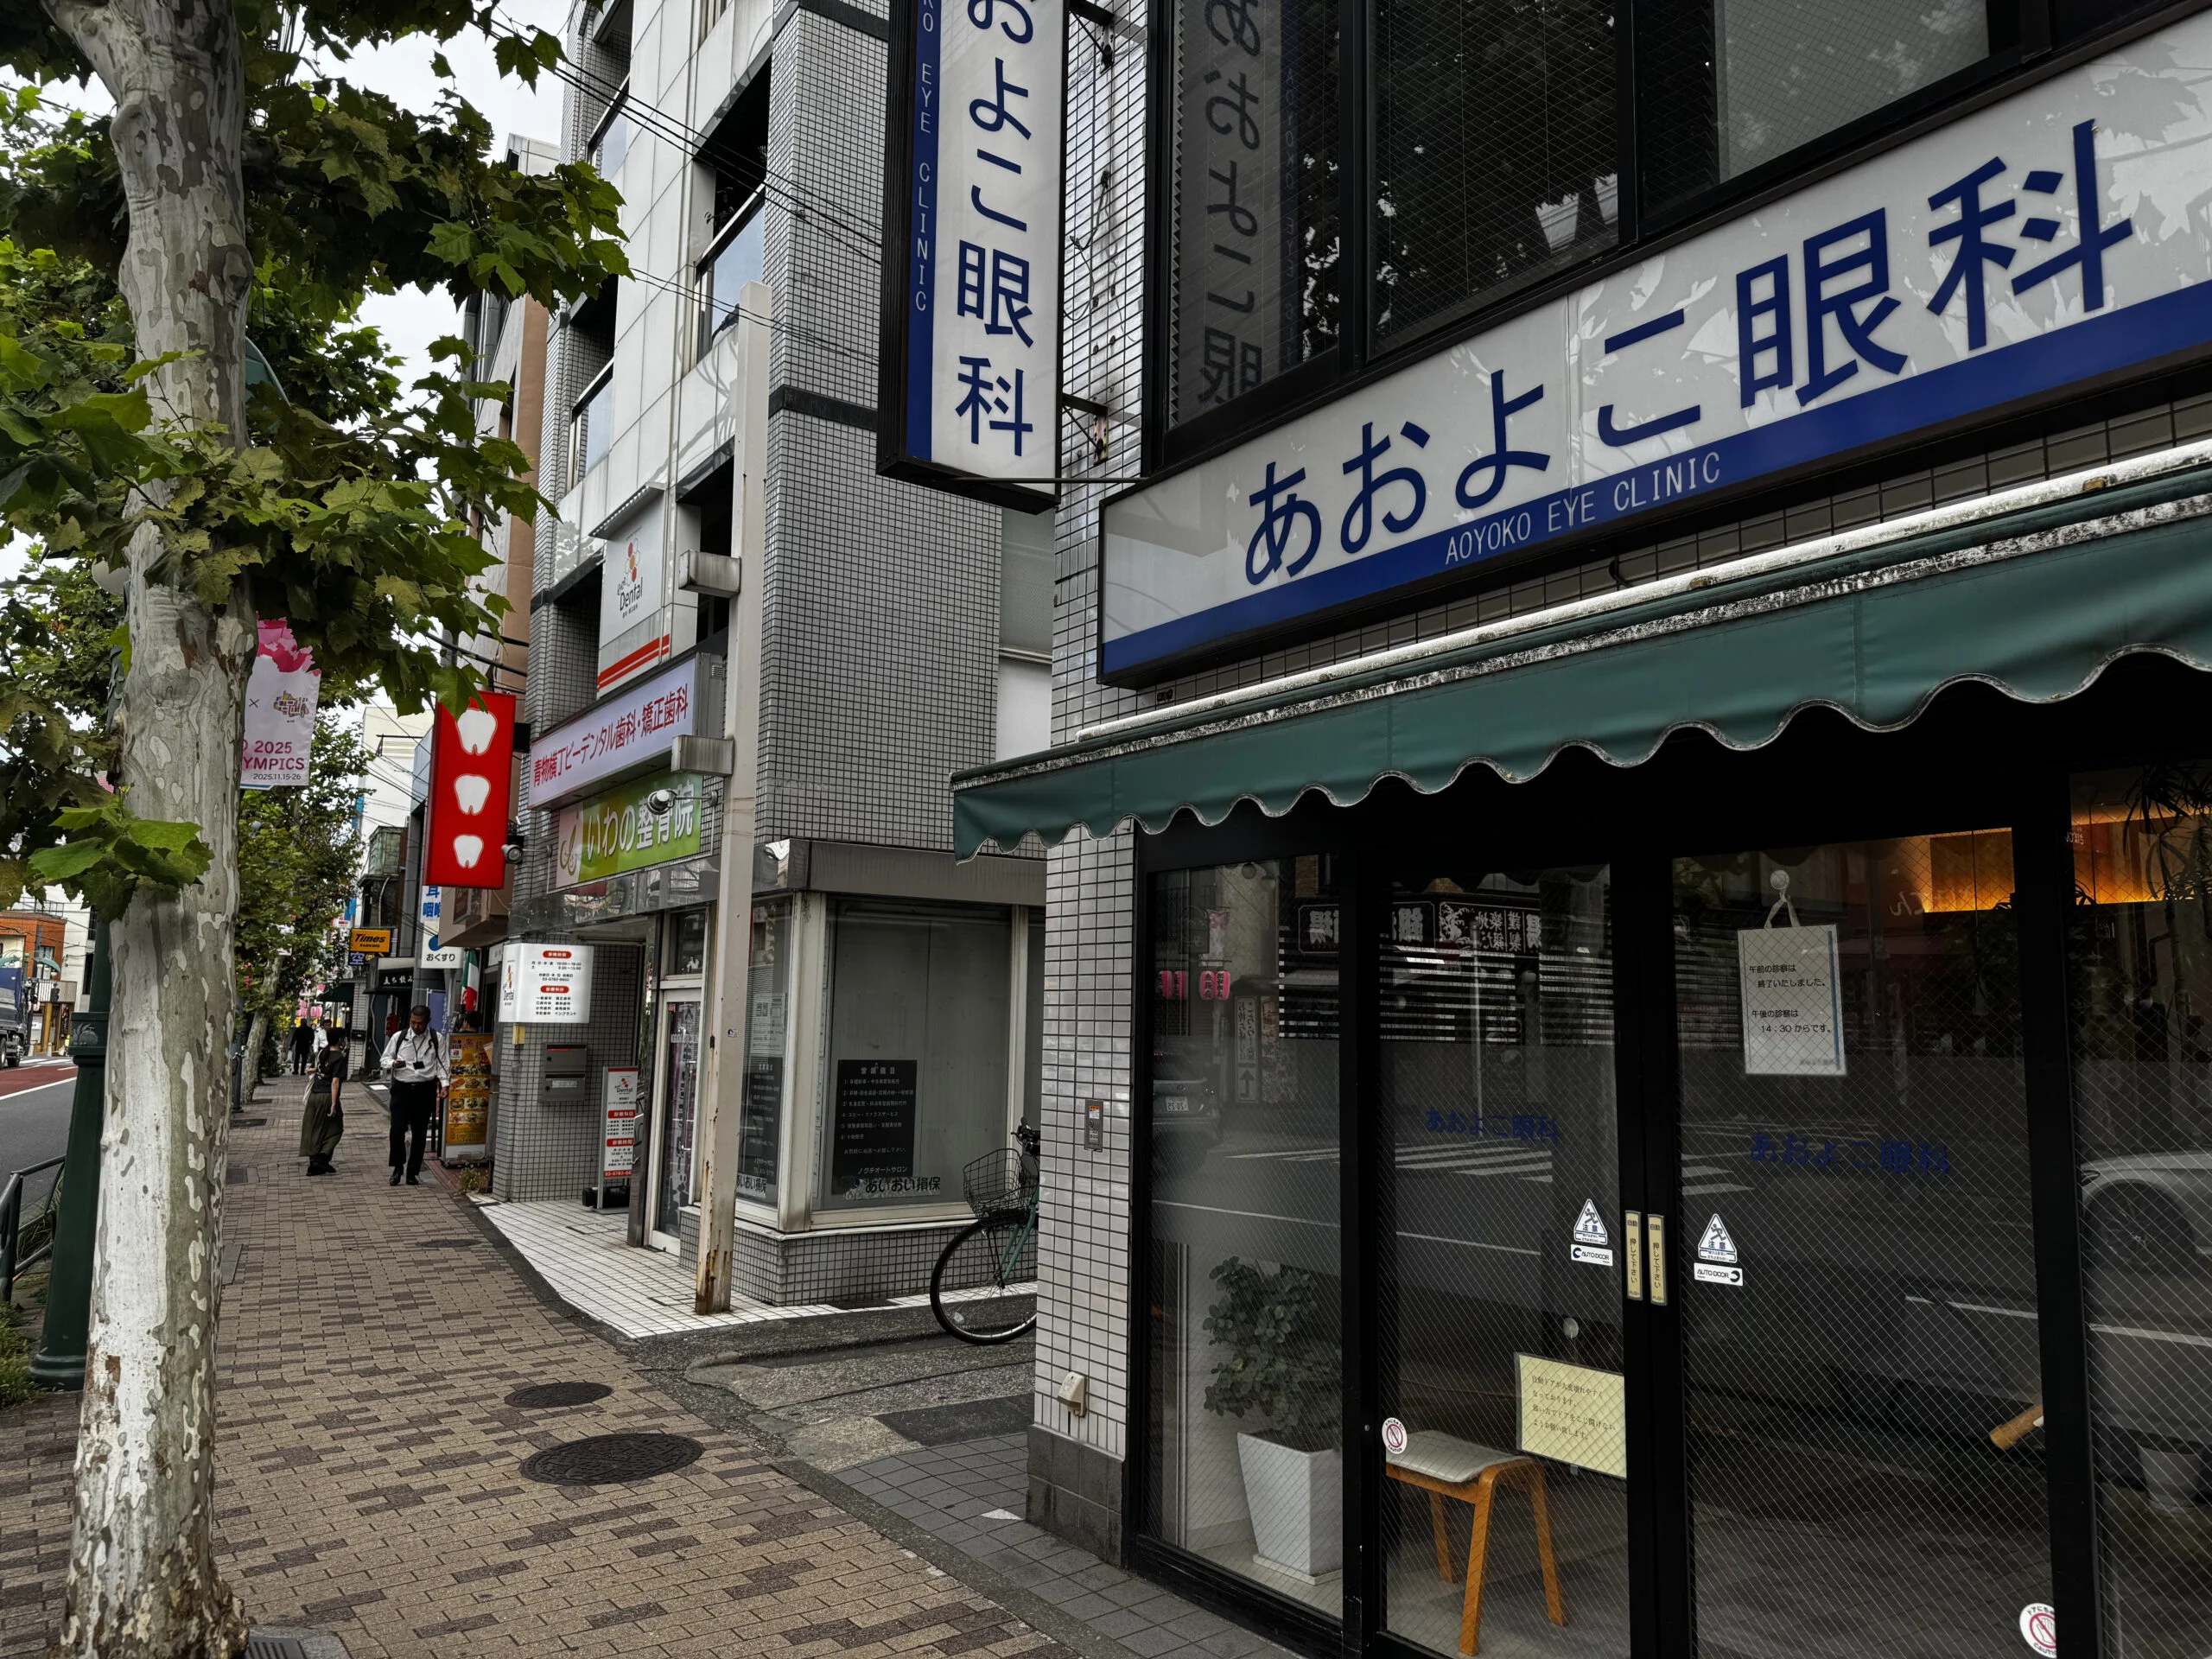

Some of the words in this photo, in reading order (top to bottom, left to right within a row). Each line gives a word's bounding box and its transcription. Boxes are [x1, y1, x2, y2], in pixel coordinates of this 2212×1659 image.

[920, 63, 932, 133] EYE
[915, 162, 931, 312] CLINIC
[1244, 118, 2133, 586] あおよこ眼科
[1446, 512, 1531, 565] AOYOKO
[1547, 490, 1595, 531] EYE
[1613, 450, 1721, 512] CLINIC
[533, 683, 689, 787] 青物横丁ビーデンタル歯科・矯正歯科
[254, 741, 292, 754] 2025
[354, 933, 386, 943] Times
[426, 953, 455, 962] おくすり
[1749, 964, 1796, 973] 午前の診察は
[383, 976, 414, 985] 立ち飲み
[1758, 978, 1826, 988] 終了いたしました。
[1751, 1009, 1799, 1018] 午後の診察は
[1426, 1107, 1557, 1143] あおよこ眼科
[1751, 1131, 1949, 1175] あおよこ眼科
[866, 1177, 940, 1193] あいおい損保
[1582, 1223, 1599, 1232] 注意
[1707, 1240, 1726, 1250] 注意
[1581, 1250, 1595, 1259] AUTO
[1652, 1242, 1662, 1288] 押して下さい
[1696, 1268, 1713, 1276] AUTO
[1713, 1270, 1730, 1279] DOOR
